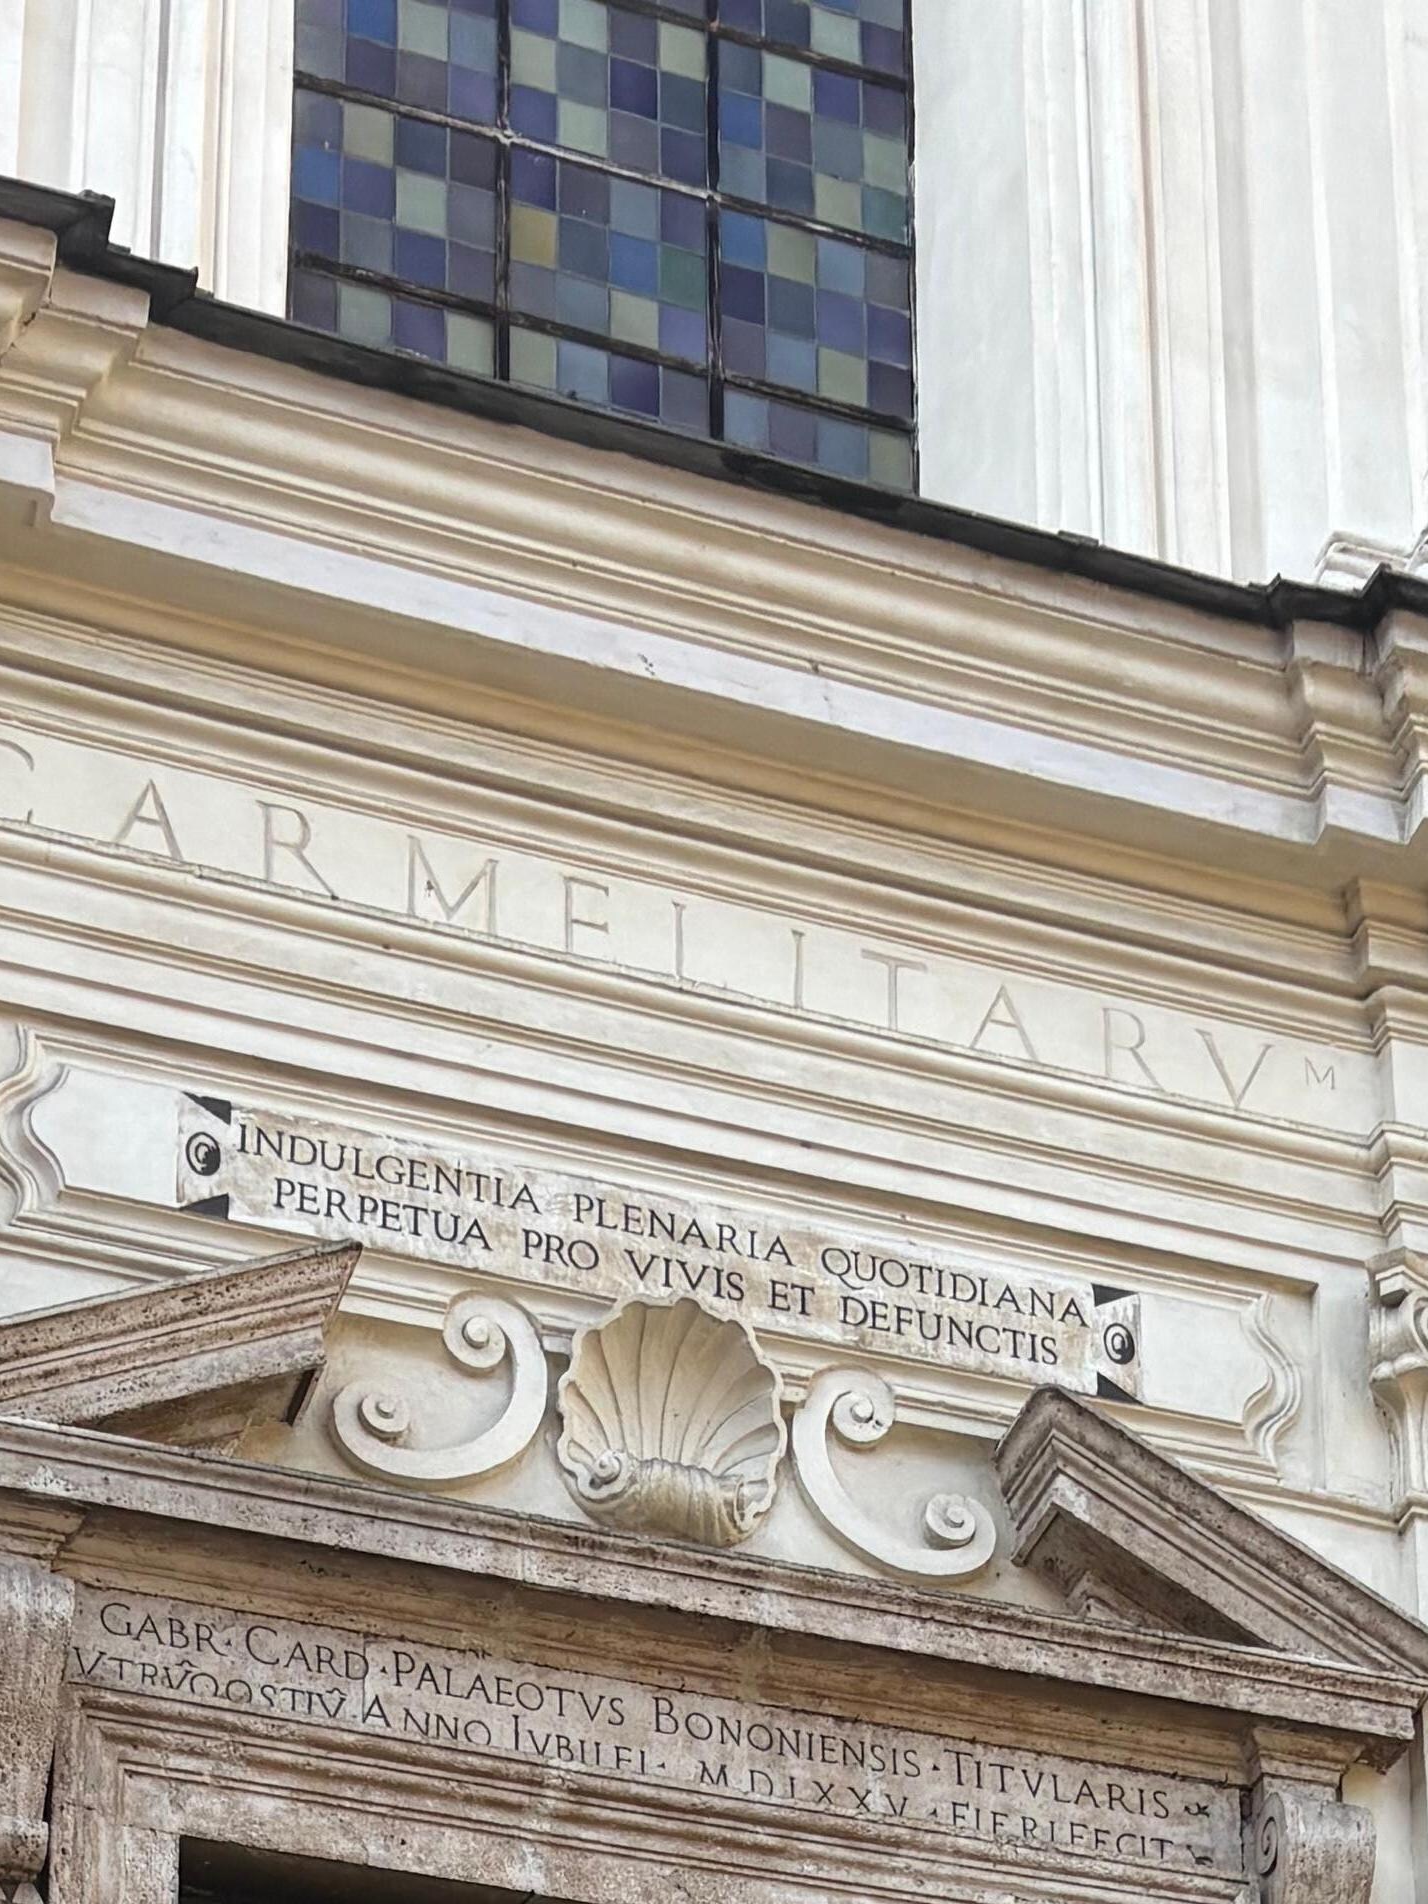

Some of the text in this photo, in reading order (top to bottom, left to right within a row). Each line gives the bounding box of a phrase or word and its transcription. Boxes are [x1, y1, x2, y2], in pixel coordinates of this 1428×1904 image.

[236, 1123, 1090, 1328] INDULGENTIA PLENARIA QUOTIDIANA
[274, 1177, 1058, 1366] PERPETUA PRO VIVIS ET DEFUNCTIS
[362, 1694, 492, 1747] ANNO
[392, 1650, 626, 1727] PALAEOTVS
[943, 1749, 1171, 1820] TITVLARIS
